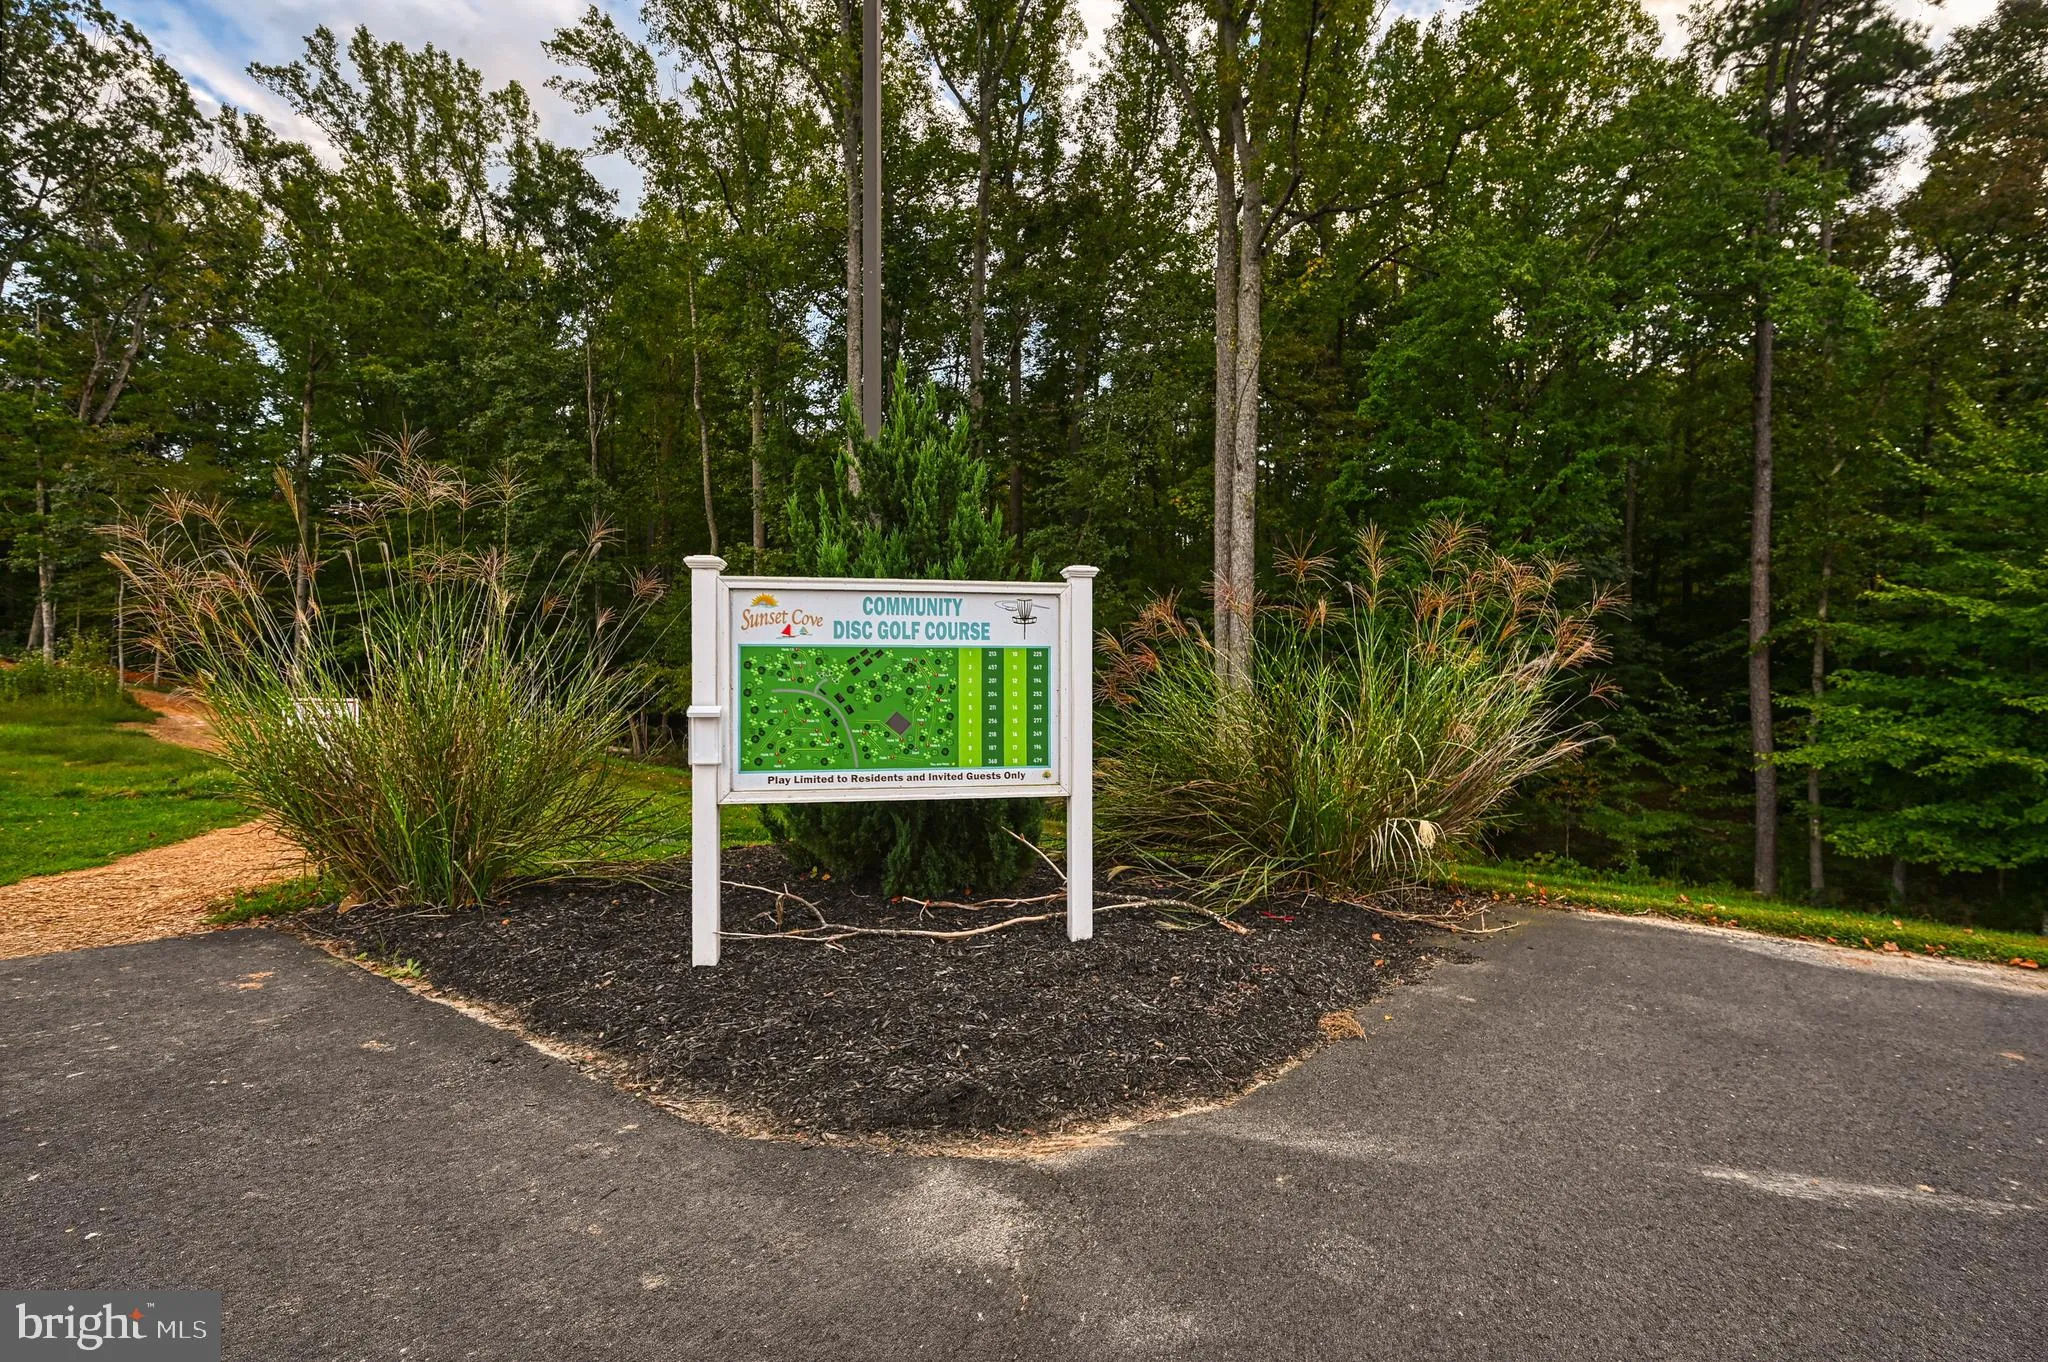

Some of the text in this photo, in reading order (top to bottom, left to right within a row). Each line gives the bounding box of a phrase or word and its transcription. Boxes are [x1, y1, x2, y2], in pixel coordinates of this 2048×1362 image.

[862, 596, 963, 616] COMMUNITY
[740, 608, 824, 631] Sunset Cove
[833, 620, 990, 641] DISC GOLF COURSE
[768, 771, 1026, 786] Play Limited to Residents and Invited Guests Only
